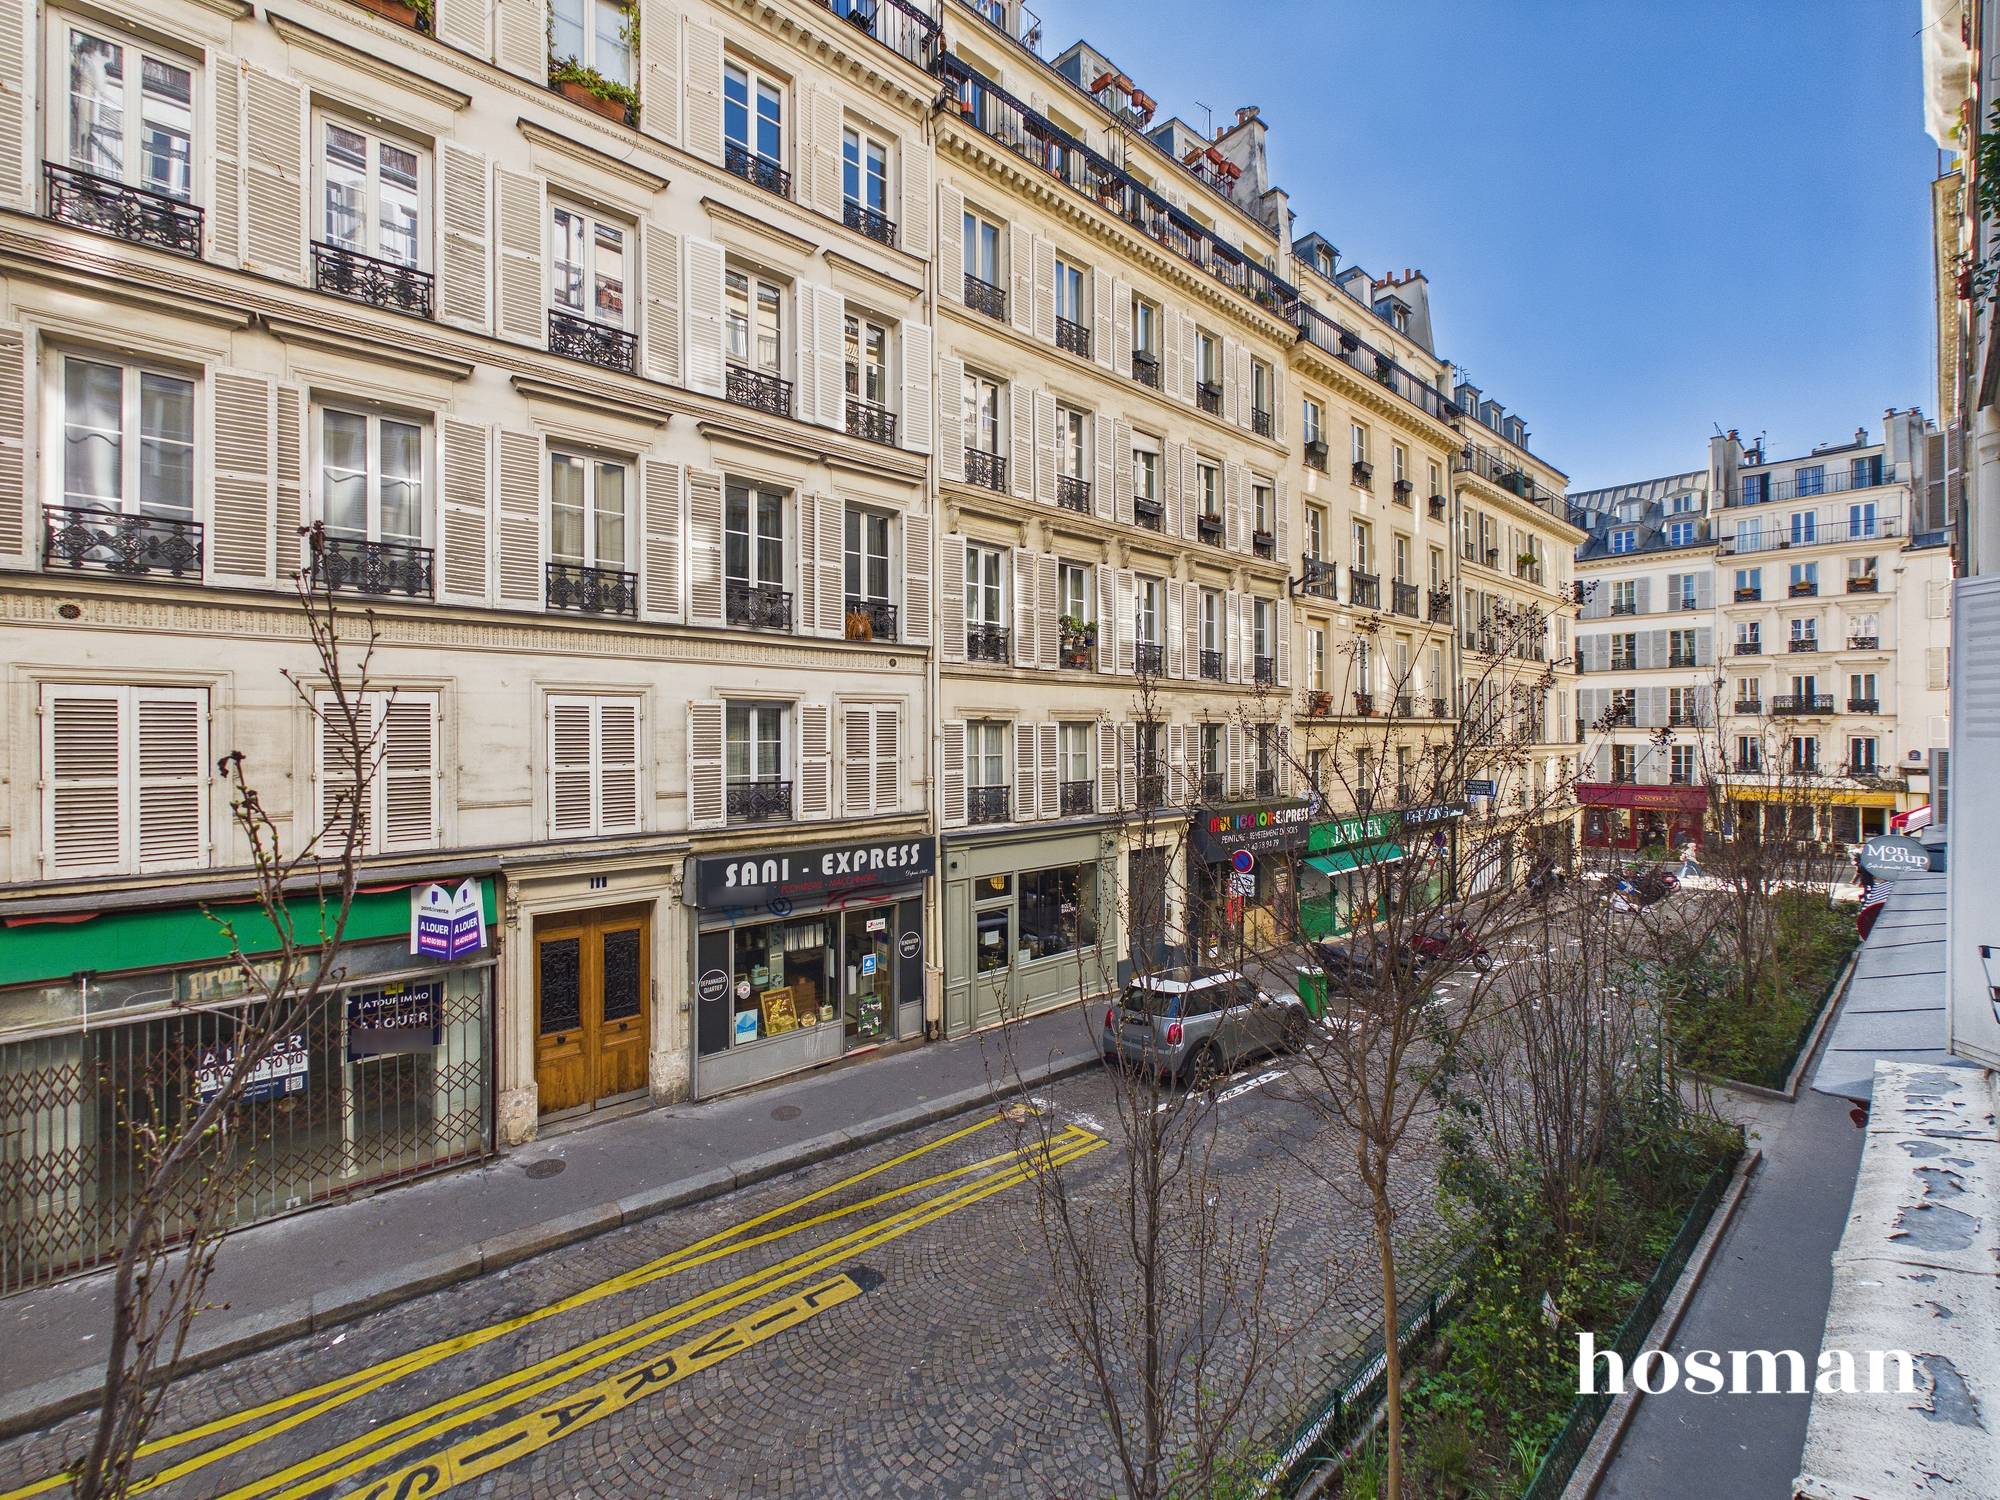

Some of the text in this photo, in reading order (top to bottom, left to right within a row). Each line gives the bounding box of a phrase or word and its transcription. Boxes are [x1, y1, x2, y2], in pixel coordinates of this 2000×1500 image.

[1210, 807, 1309, 832] MULICOLOR-EXPRESS
[1867, 844, 1909, 857] Mon
[725, 858, 789, 888] SANI
[821, 843, 920, 876] EXPRESS
[1880, 854, 1928, 867] Loup
[420, 921, 449, 936] A LOUER
[454, 917, 478, 935] A LOUER
[400, 992, 429, 1003] IMMO
